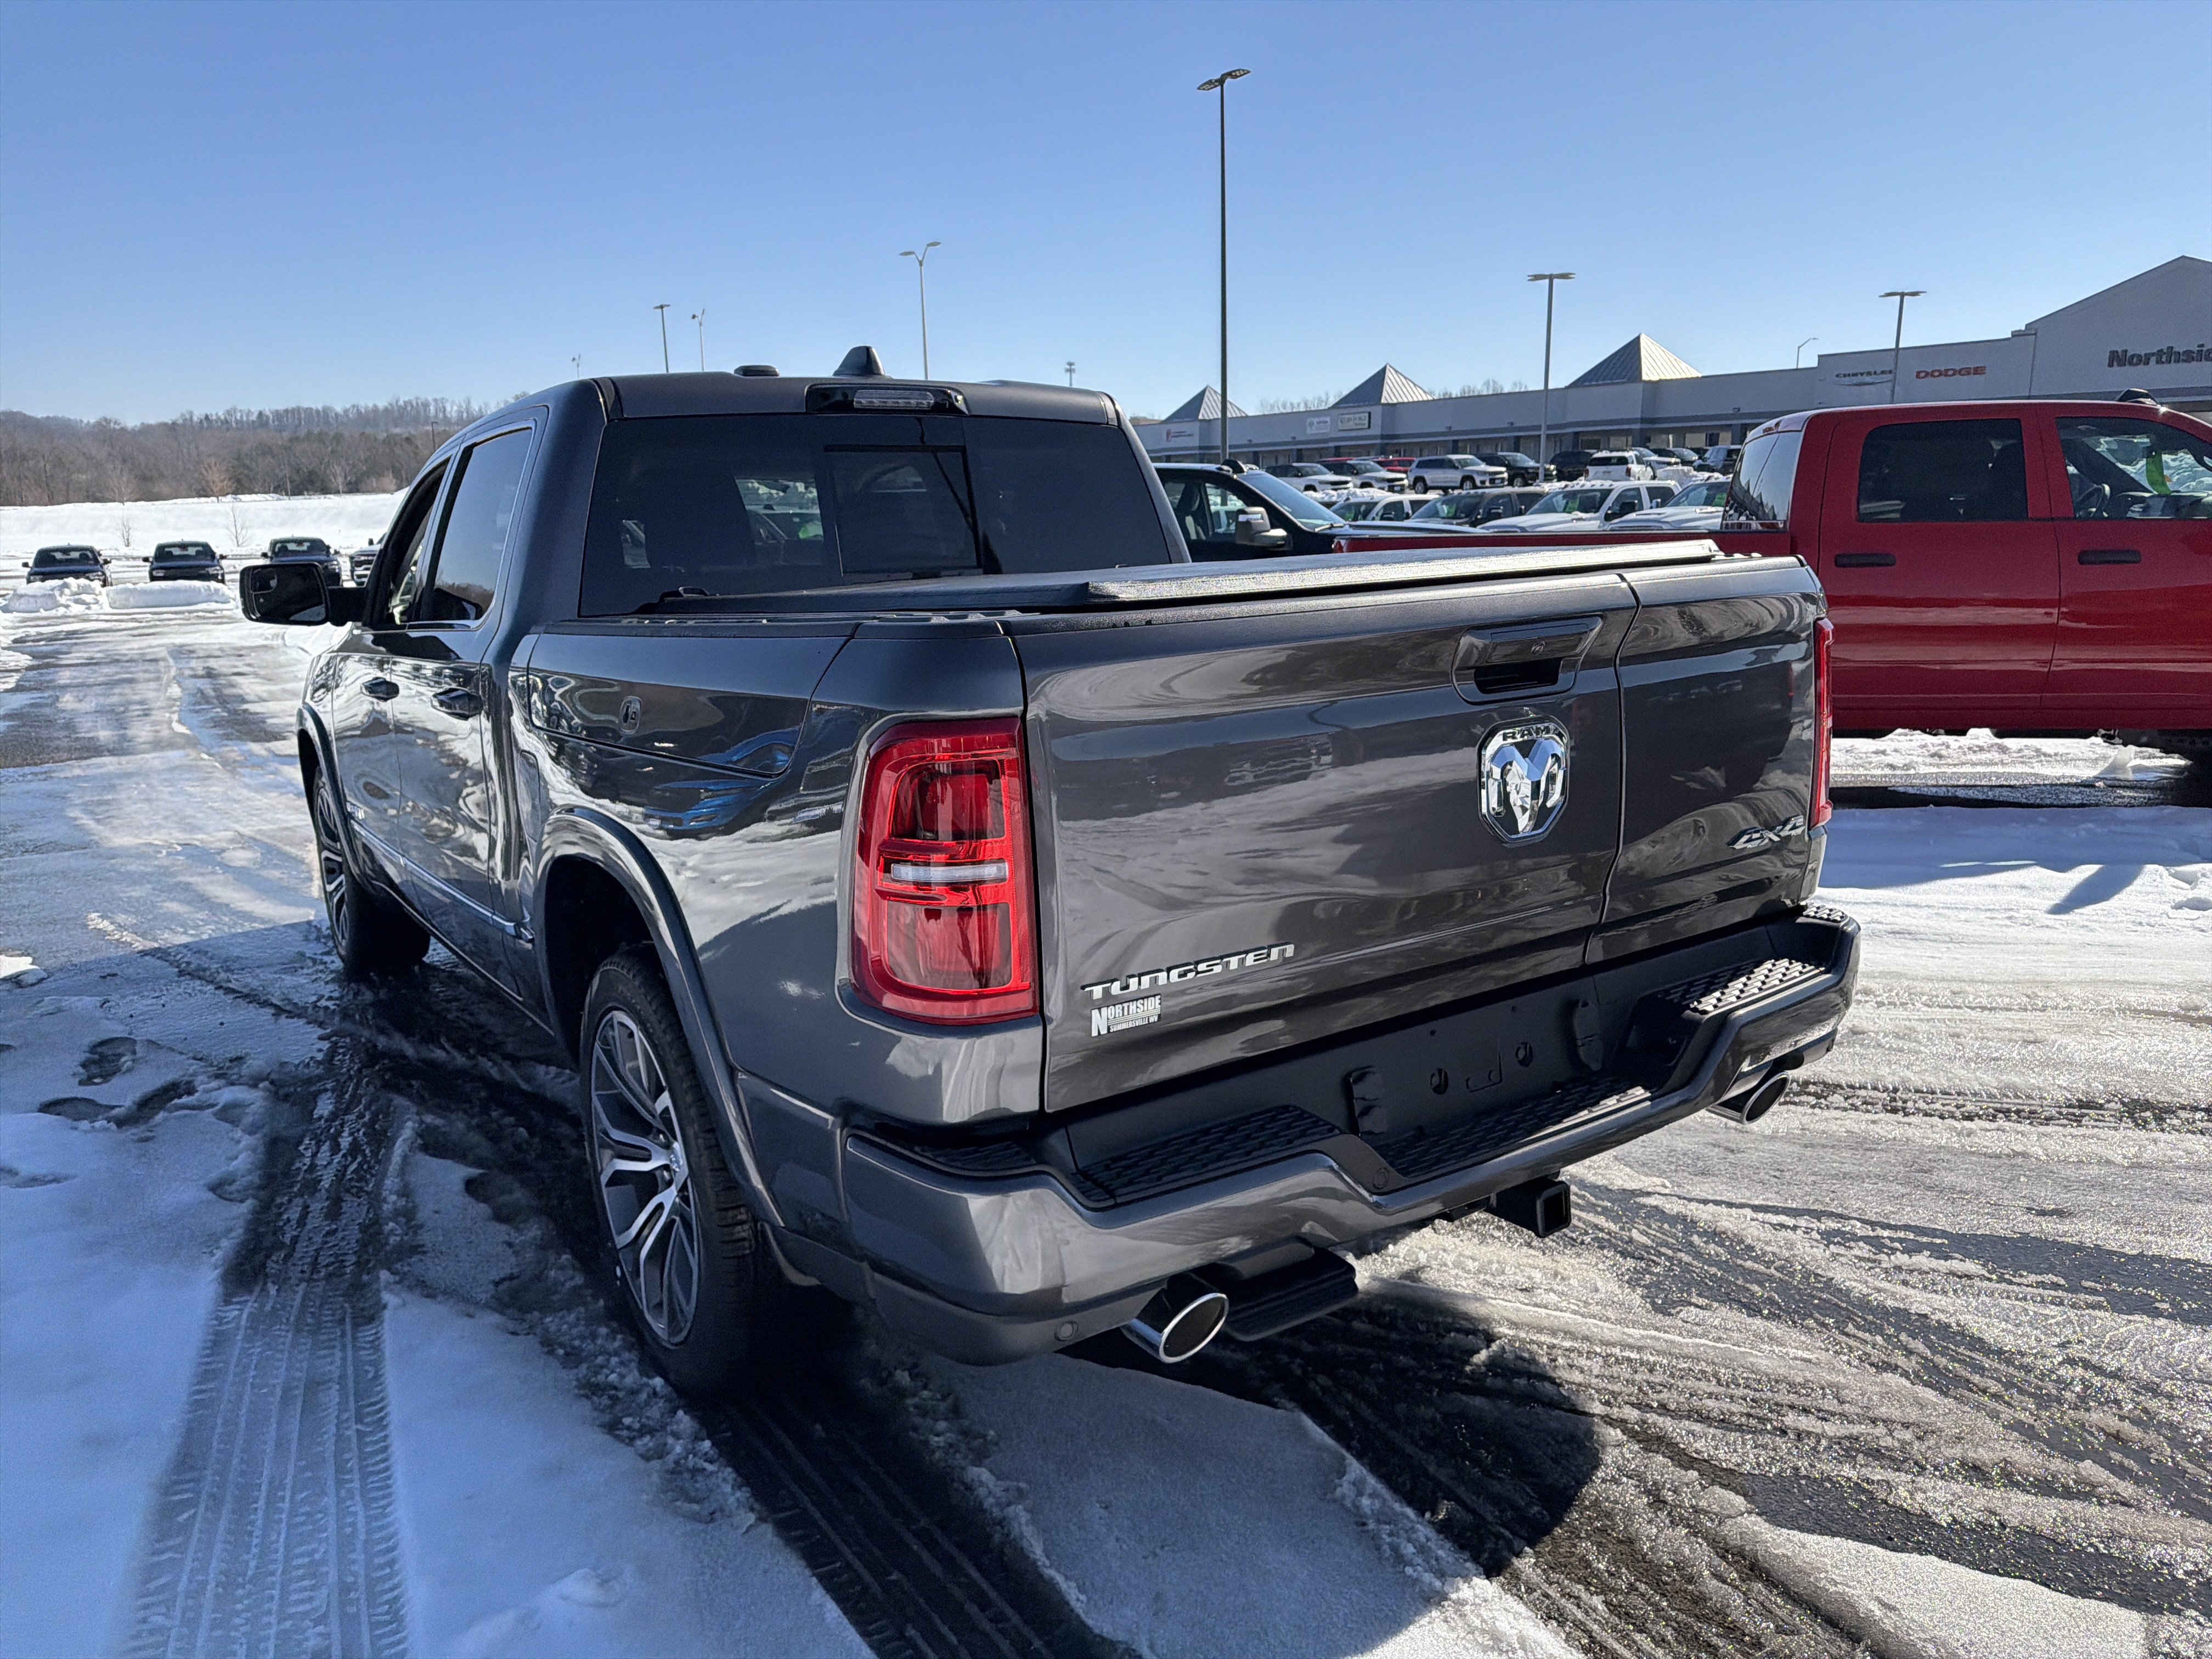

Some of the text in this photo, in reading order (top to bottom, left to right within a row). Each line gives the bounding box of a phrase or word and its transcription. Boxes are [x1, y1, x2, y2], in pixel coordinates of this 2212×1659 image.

[1916, 365, 1986, 380] DODGE
[1502, 725, 1550, 742] RAM
[1081, 941, 1295, 1000] TUNGSTEN
[1091, 995, 1161, 1037] NORTHSIDE
[1109, 1014, 1159, 1032] SUMMERSVILLE WV
